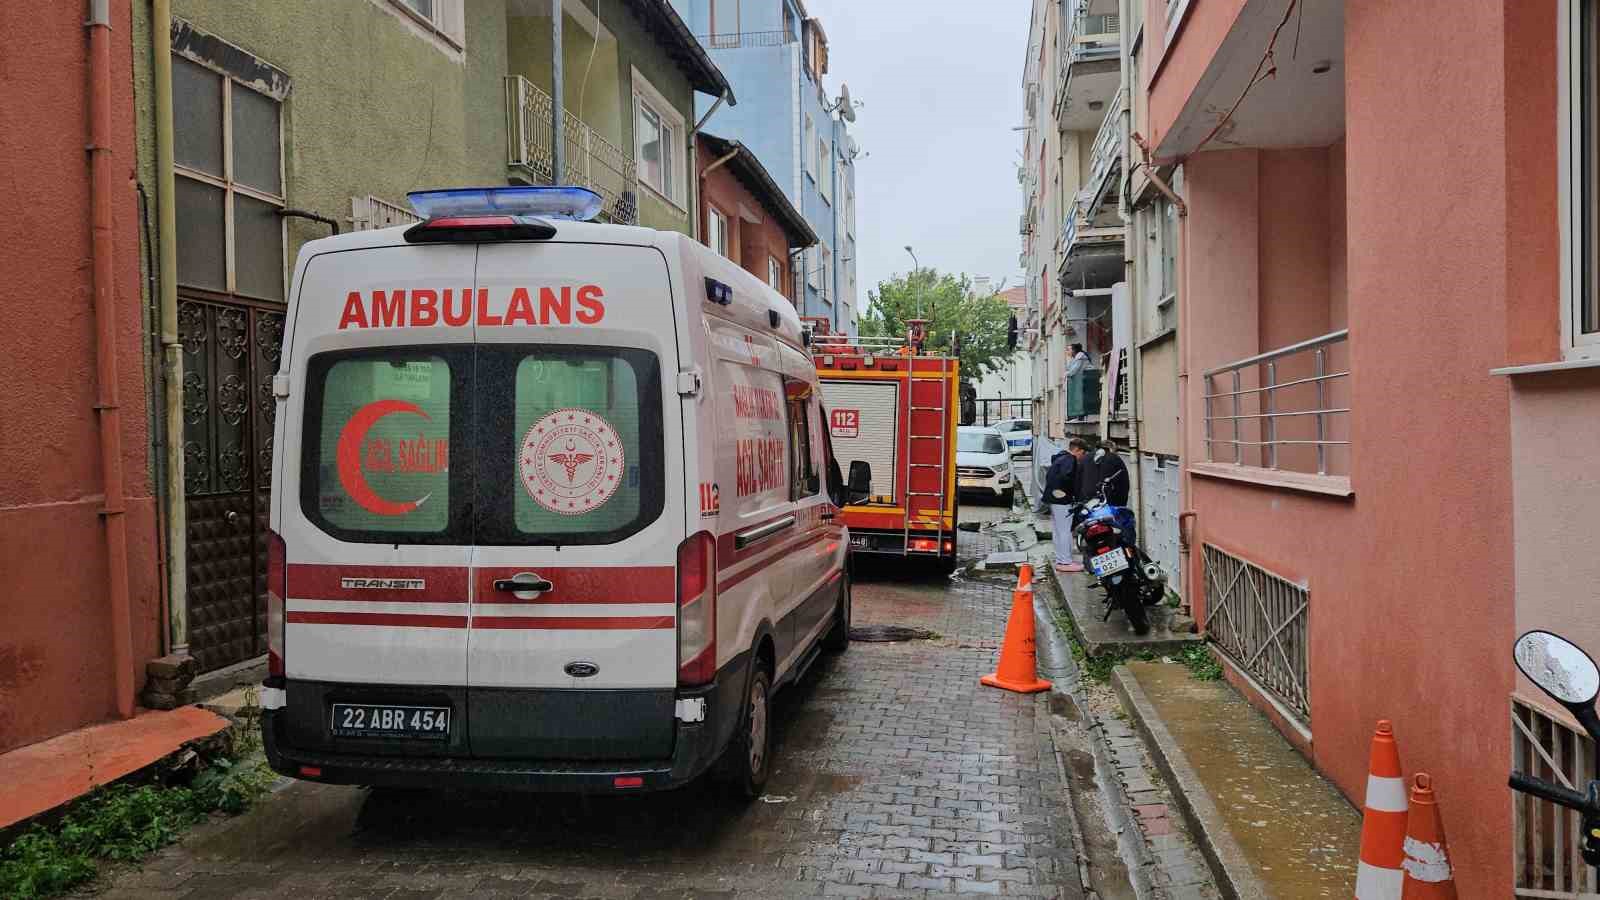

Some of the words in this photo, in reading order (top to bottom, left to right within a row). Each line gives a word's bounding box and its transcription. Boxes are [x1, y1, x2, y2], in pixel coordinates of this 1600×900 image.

[338, 285, 604, 329] AMBULANS
[834, 411, 856, 427] 112
[700, 483, 720, 510] 112
[342, 579, 424, 590] TRANSIT
[342, 708, 365, 728] 22
[370, 708, 405, 730] ABR
[410, 710, 446, 731] 454
